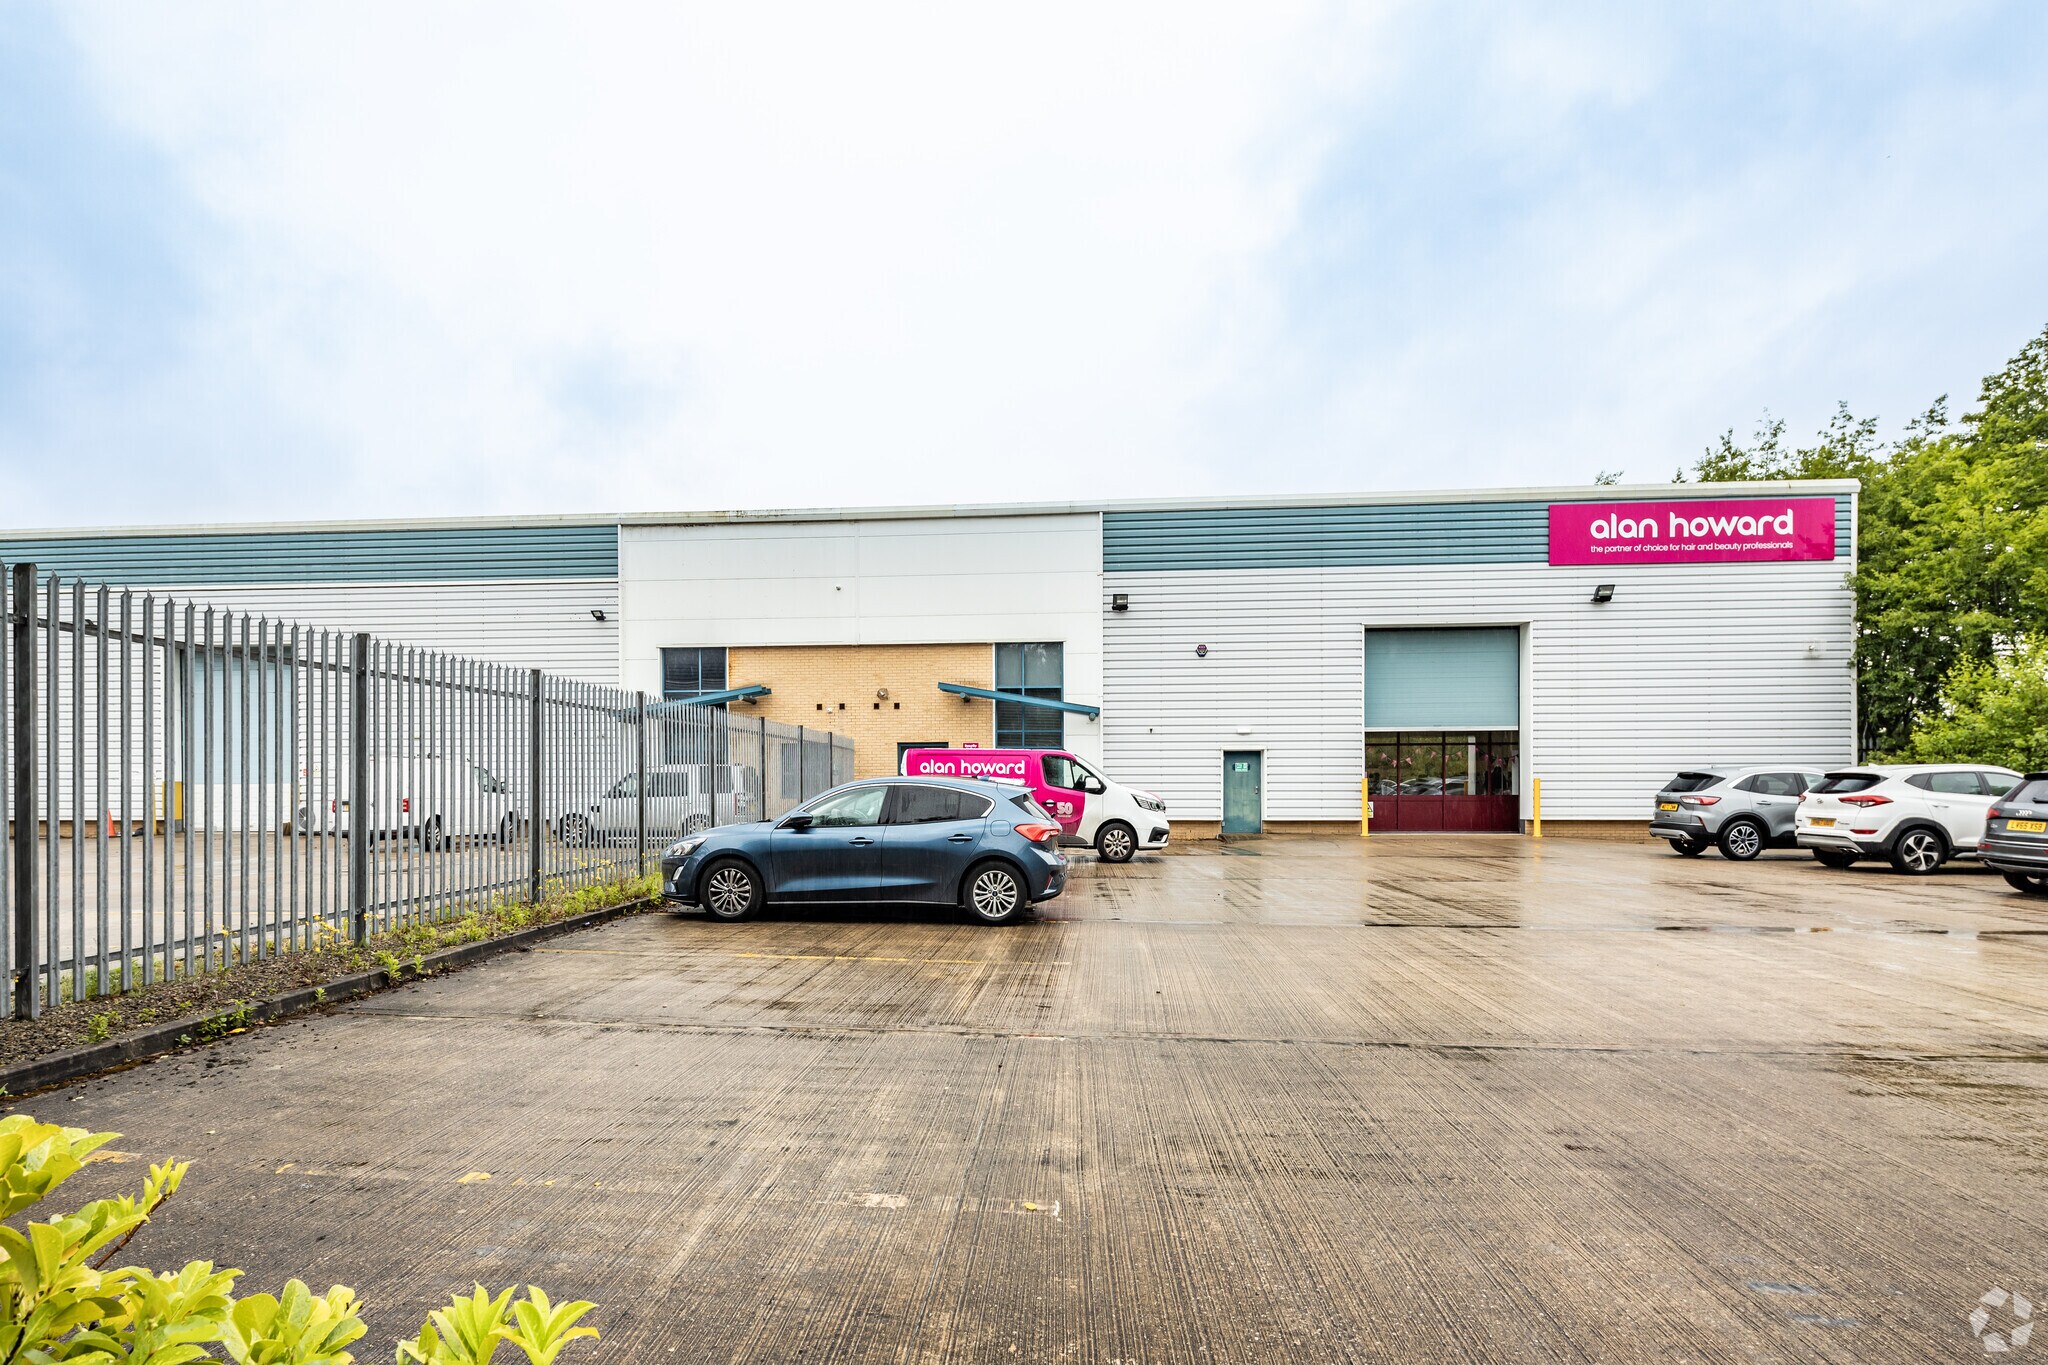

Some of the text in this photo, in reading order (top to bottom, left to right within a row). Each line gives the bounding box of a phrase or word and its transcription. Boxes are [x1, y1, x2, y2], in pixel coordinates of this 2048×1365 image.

[1590, 508, 1794, 539] alan howard
[1590, 541, 1794, 554] the partner of choice for hair and beauty professionals
[919, 759, 1025, 775] alan howard
[1056, 801, 1073, 815] 50
